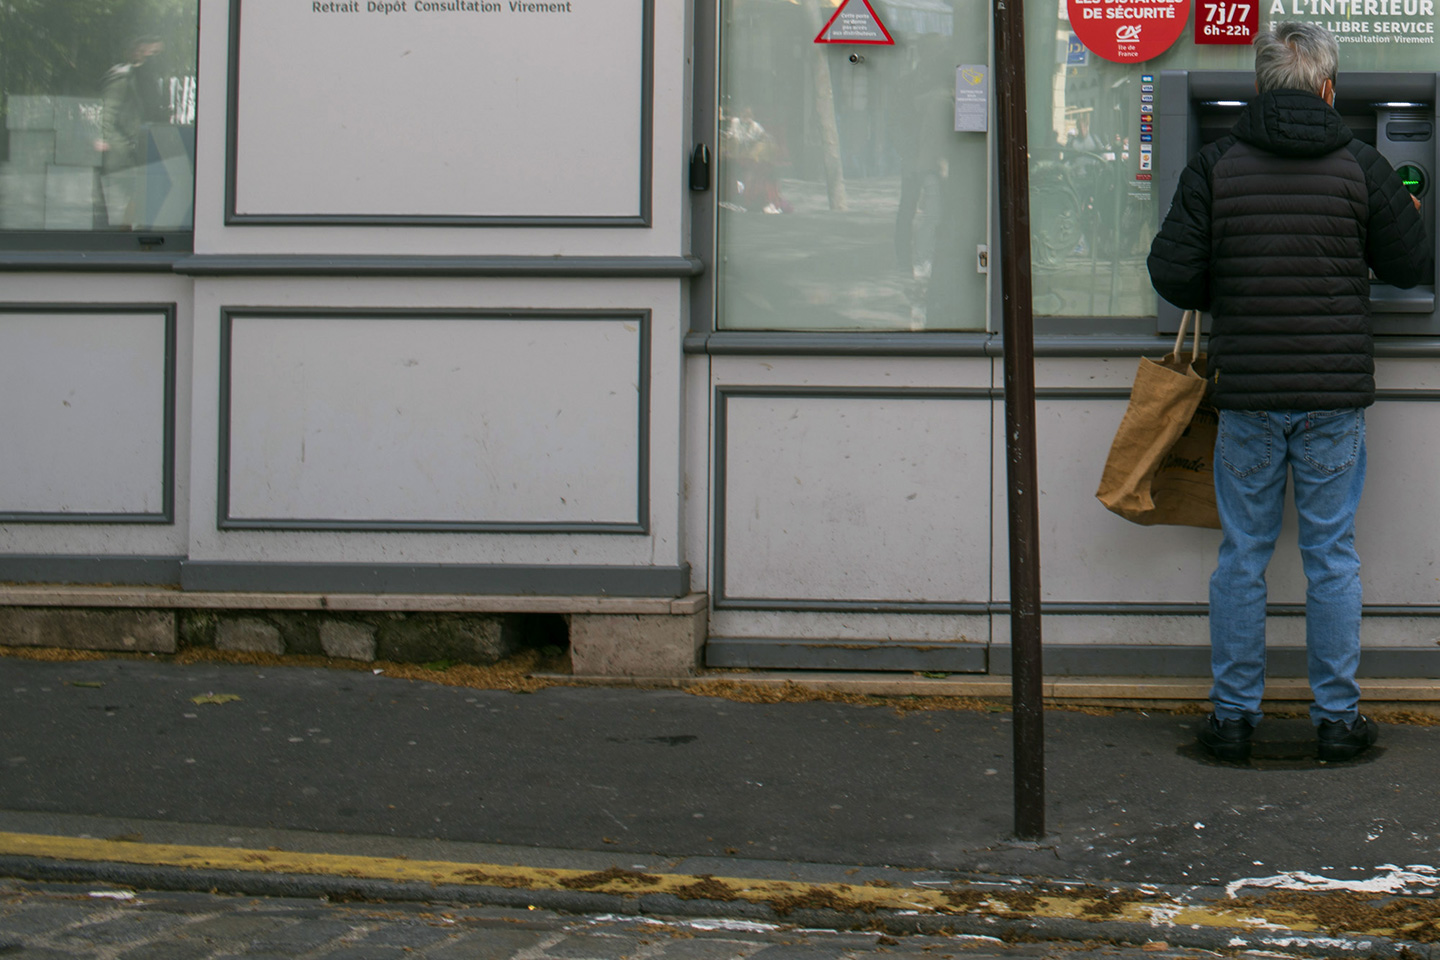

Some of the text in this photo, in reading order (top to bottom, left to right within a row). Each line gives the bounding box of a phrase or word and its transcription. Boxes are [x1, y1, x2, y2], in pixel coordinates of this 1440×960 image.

[312, 0, 360, 13] Retrait
[367, 0, 407, 15] Dépôt
[508, 0, 572, 13] Virement
[1083, 4, 1175, 19] DE SÉCURITÉ
[1203, 2, 1251, 25] 7j/7
[1203, 24, 1250, 36] 6h-22h
[1328, 21, 1369, 33] LIBRE
[1373, 21, 1434, 33] SERVICE
[1334, 34, 1434, 43] Consultation Virement
